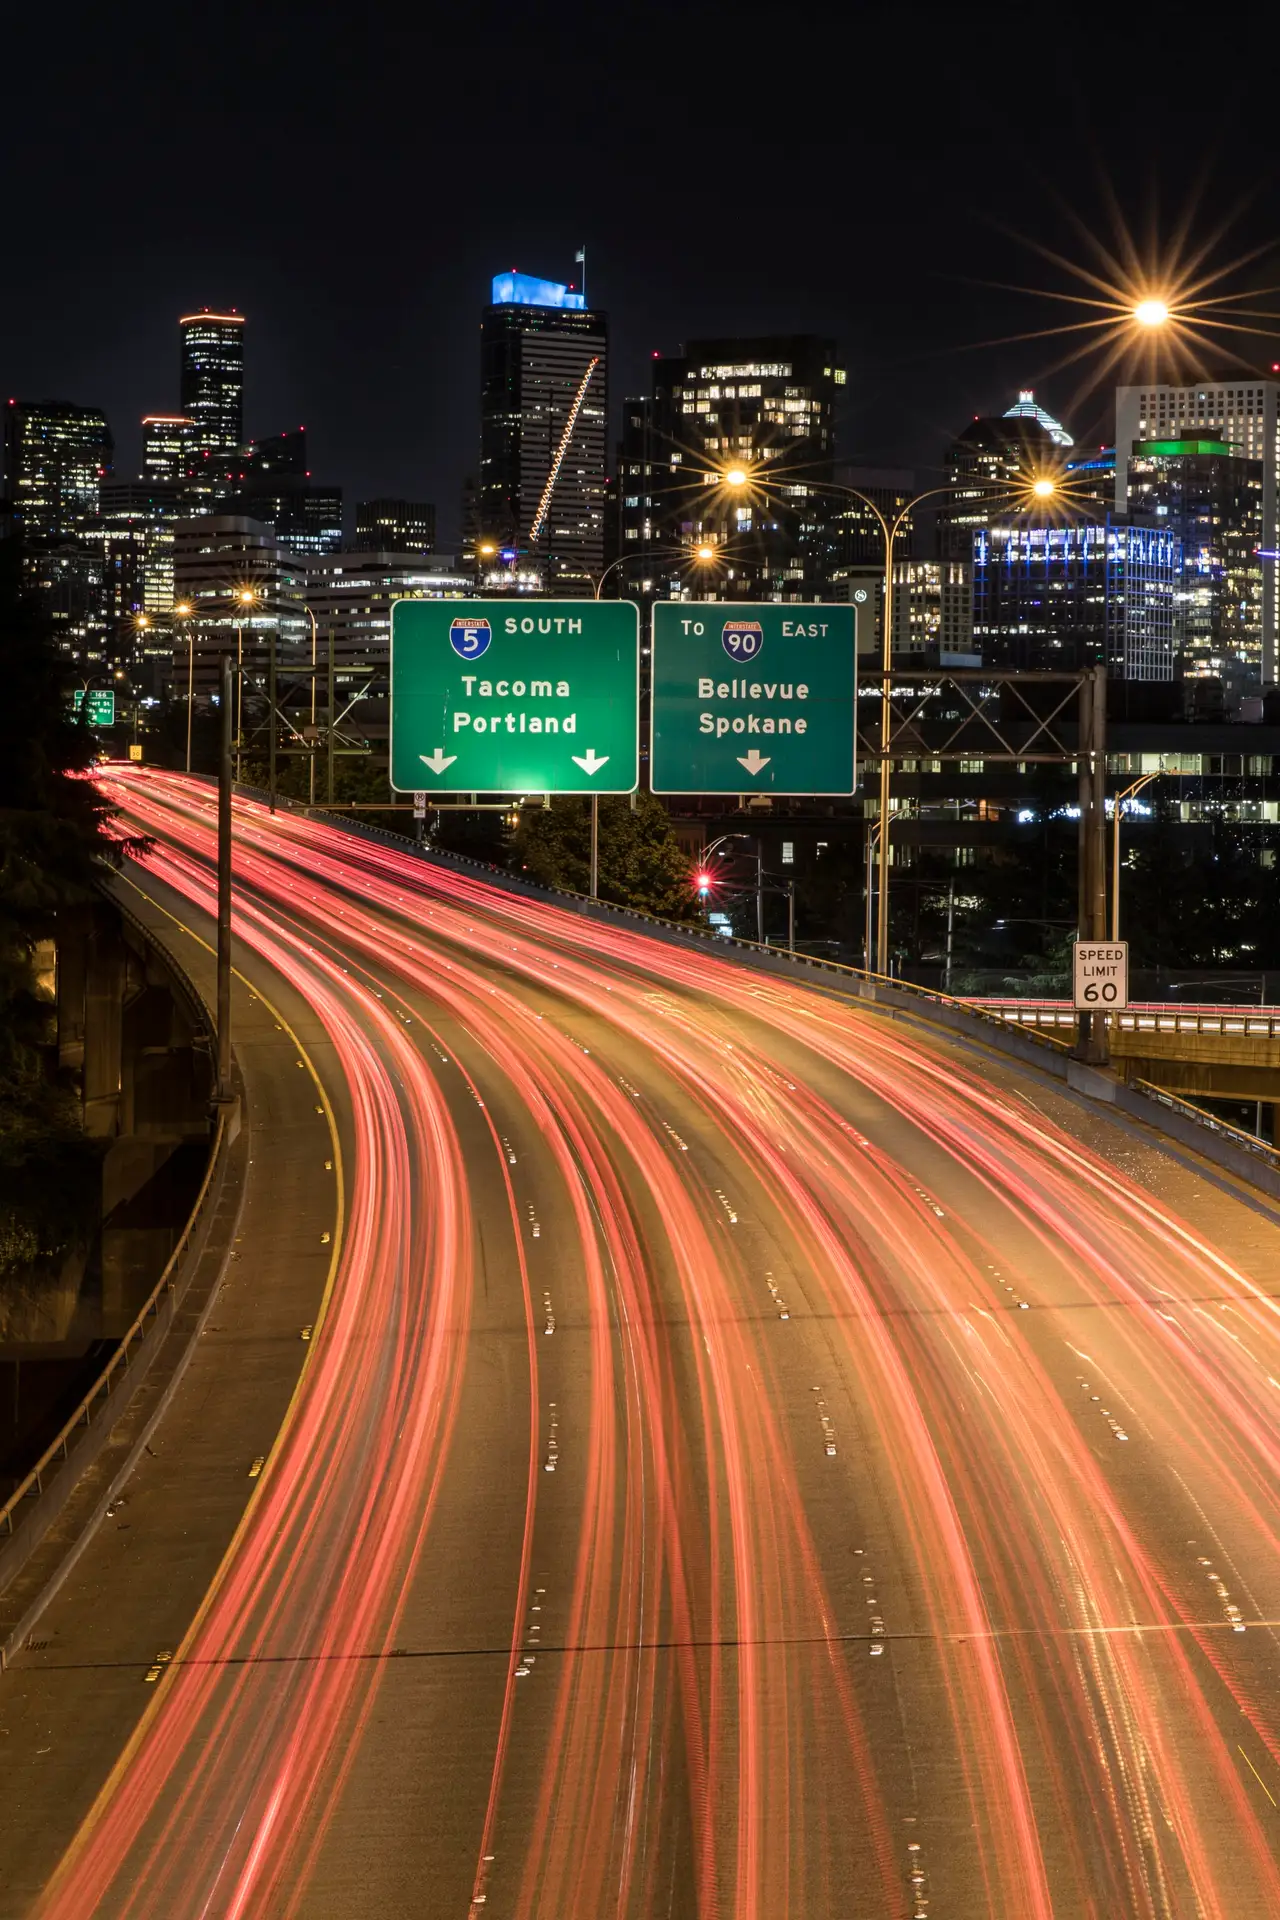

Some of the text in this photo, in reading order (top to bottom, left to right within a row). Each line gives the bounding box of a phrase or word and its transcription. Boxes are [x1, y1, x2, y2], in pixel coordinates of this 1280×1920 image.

[505, 617, 582, 634] SOUTH
[782, 621, 829, 637] EAST
[463, 629, 479, 652] 5
[728, 634, 756, 653] 90
[461, 675, 570, 697] Tacoma
[698, 678, 809, 699] Bellevue
[453, 712, 576, 733] Portland
[699, 712, 807, 738] Spokane
[1079, 950, 1123, 960] SPEED
[1083, 966, 1118, 976] LIMIT
[1084, 982, 1118, 1002] 60
